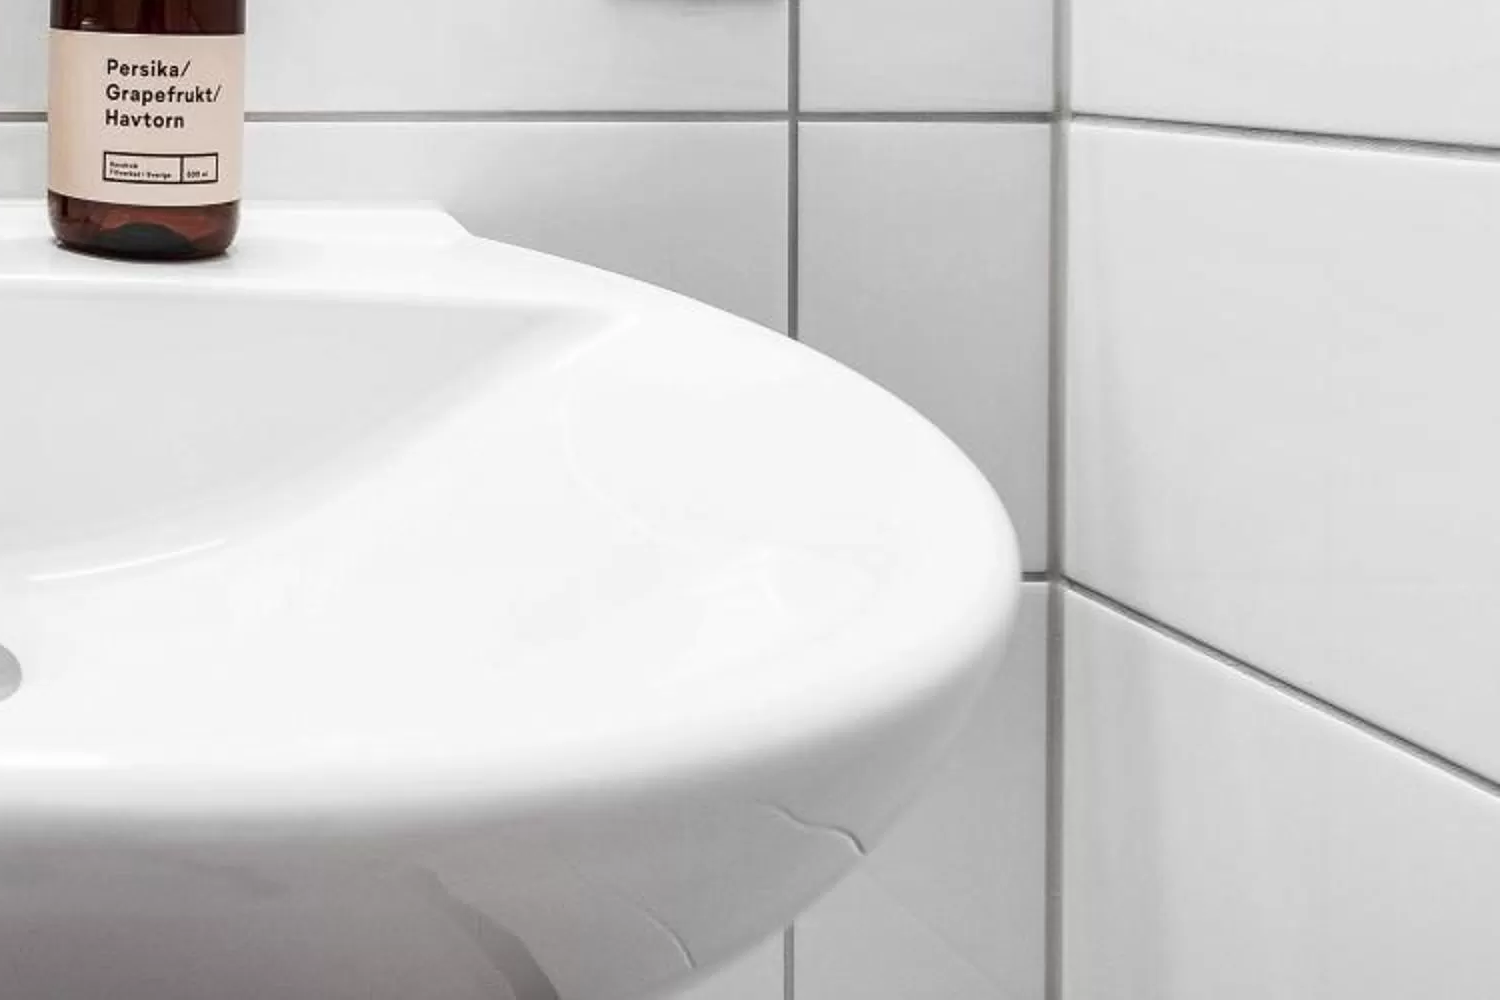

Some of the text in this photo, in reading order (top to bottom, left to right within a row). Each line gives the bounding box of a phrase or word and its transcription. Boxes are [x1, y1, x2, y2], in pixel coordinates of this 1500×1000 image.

[107, 59, 191, 78] Persika/
[106, 84, 221, 106] Grapefrukt/
[106, 109, 184, 128] Havtorn
